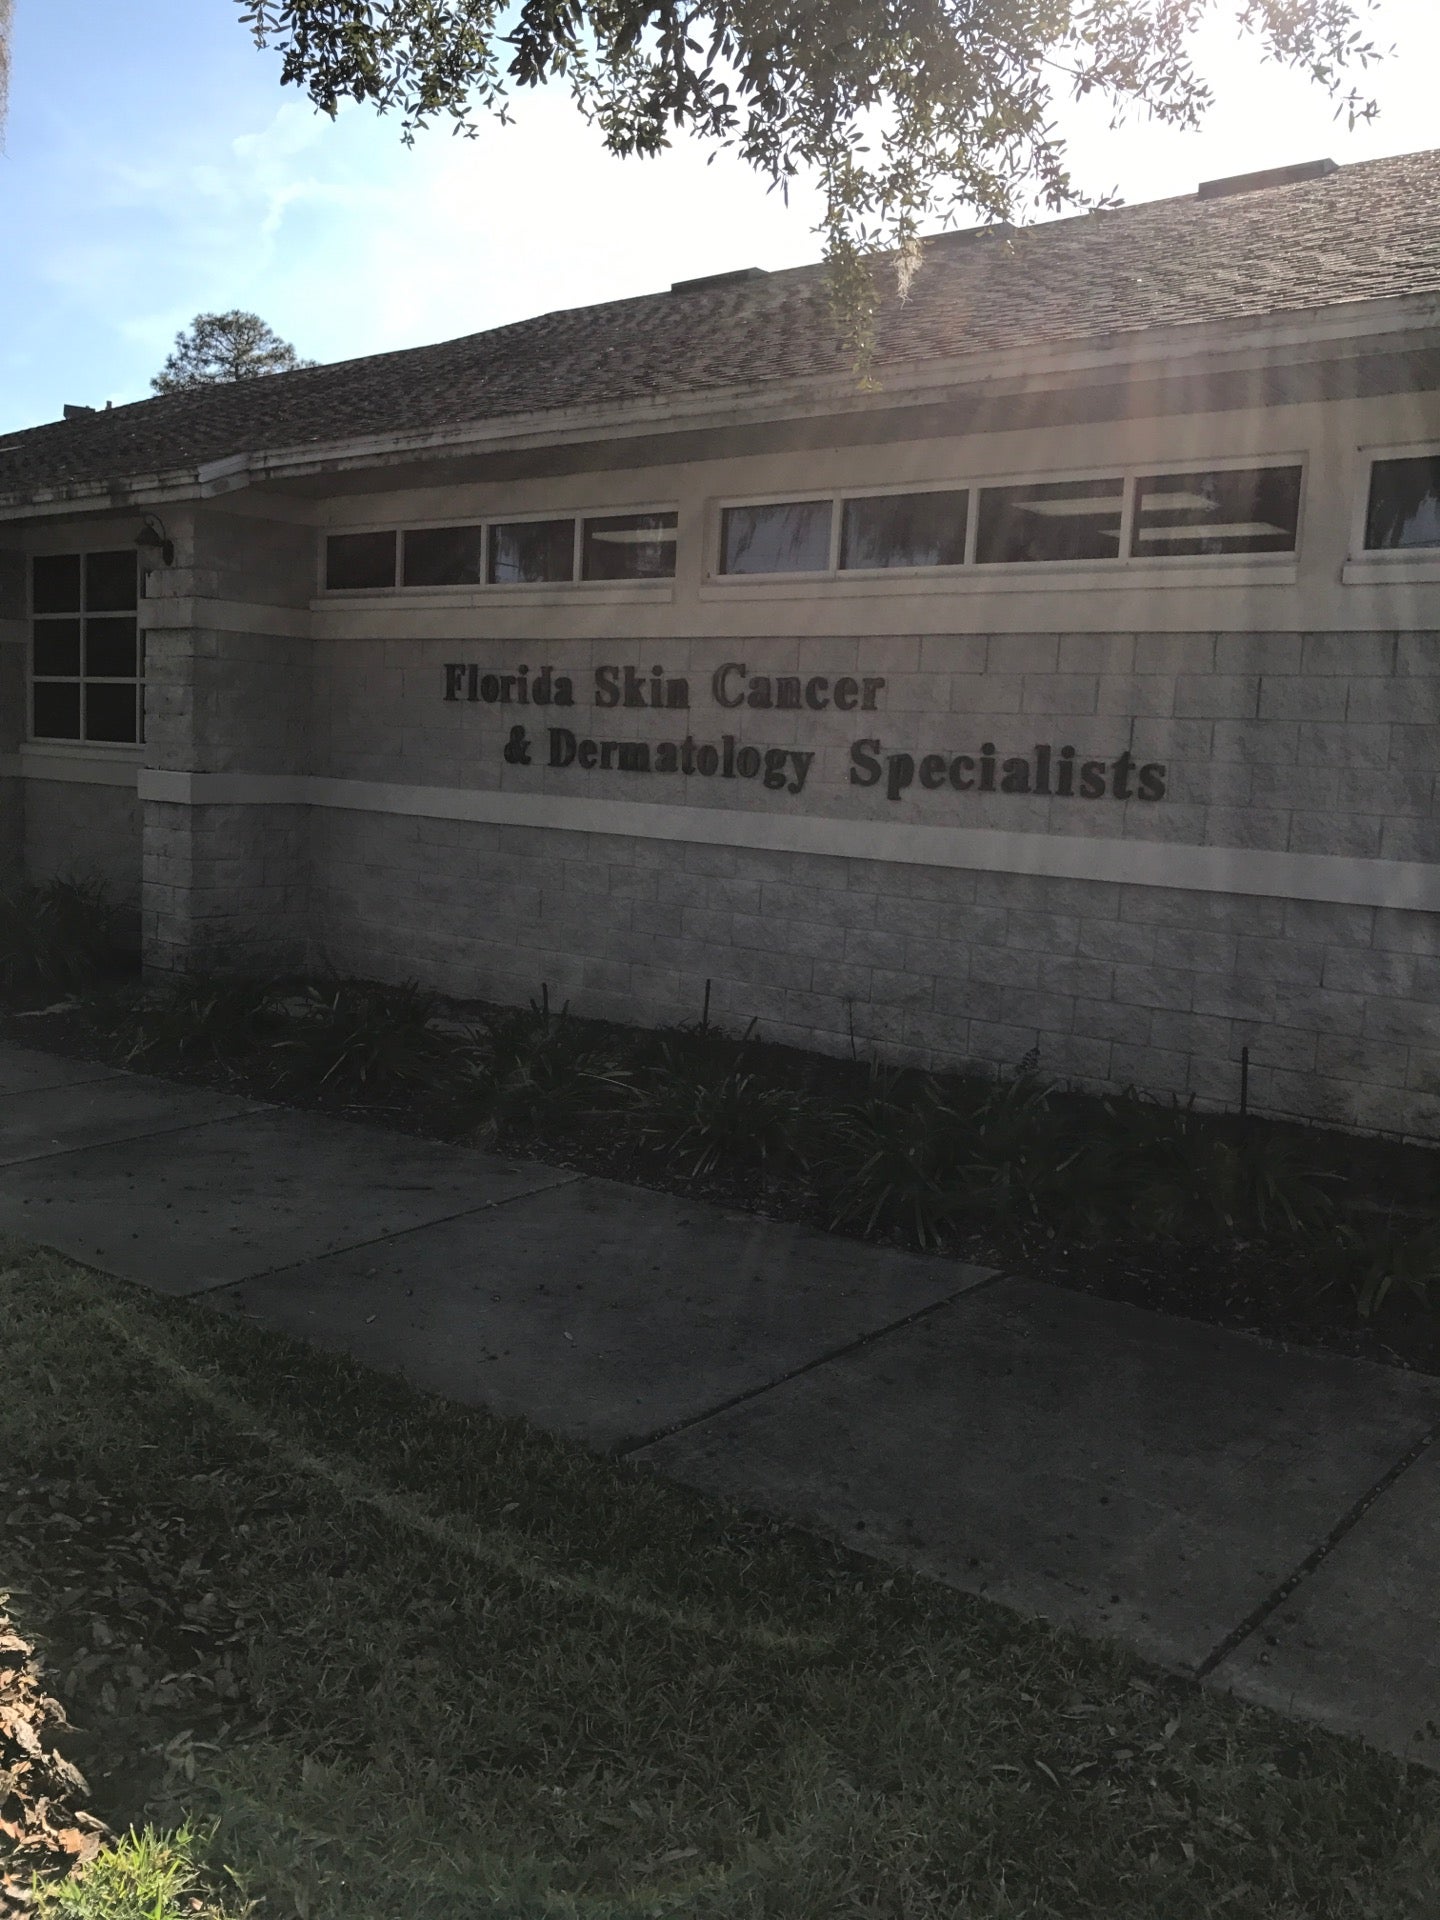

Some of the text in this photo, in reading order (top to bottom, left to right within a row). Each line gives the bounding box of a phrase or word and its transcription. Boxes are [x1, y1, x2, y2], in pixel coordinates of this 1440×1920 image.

[443, 662, 886, 711] Florida Skin Cancer
[503, 724, 1167, 801] & Dermatology Specialists
